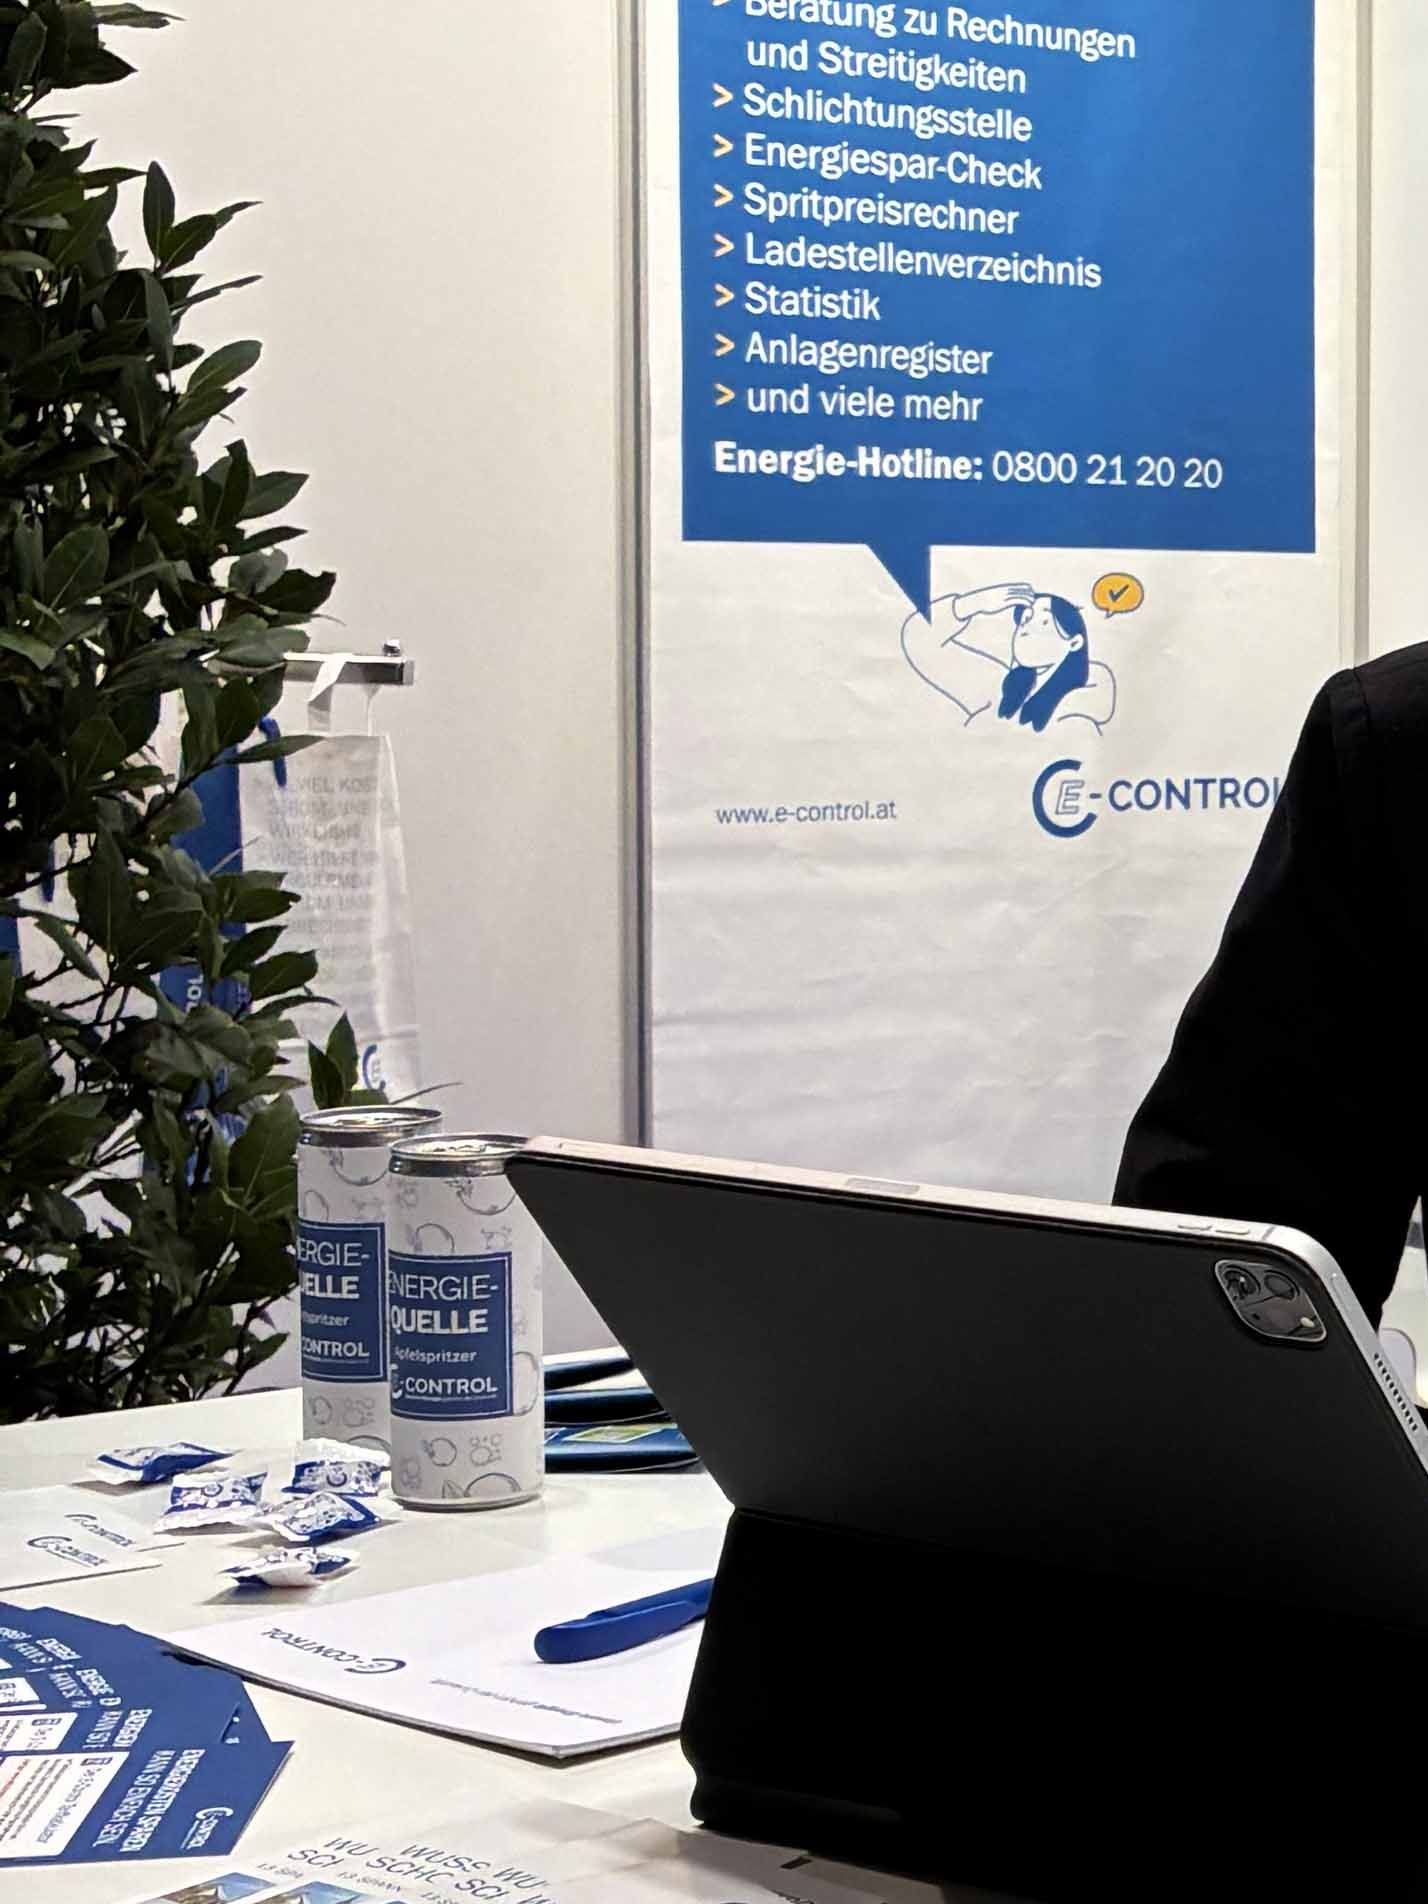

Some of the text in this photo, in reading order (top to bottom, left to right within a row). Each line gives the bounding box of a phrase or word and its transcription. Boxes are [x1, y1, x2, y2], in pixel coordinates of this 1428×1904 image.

[904, 8, 938, 39] zu
[947, 7, 1135, 59] Rechnungen
[747, 39, 1027, 94] und Streitigkeiten
[743, 84, 1032, 143] Schlichtungsstelle
[745, 133, 1042, 191] Energiespar-Check
[743, 183, 1019, 236] Spritpreisrechner
[745, 234, 1102, 289] Ladestellenverzeichnis
[744, 283, 881, 322] Statistik
[745, 332, 992, 377] Anlagenregister
[747, 385, 982, 424] und viele mehr
[713, 442, 1223, 489] Energie-Hotline: 0800 21 20 20
[716, 800, 897, 825] www.e-control.at
[298, 1238, 370, 1267] ERGIE-
[301, 1272, 360, 1299] ELLE
[391, 1305, 488, 1334] QUELLE
